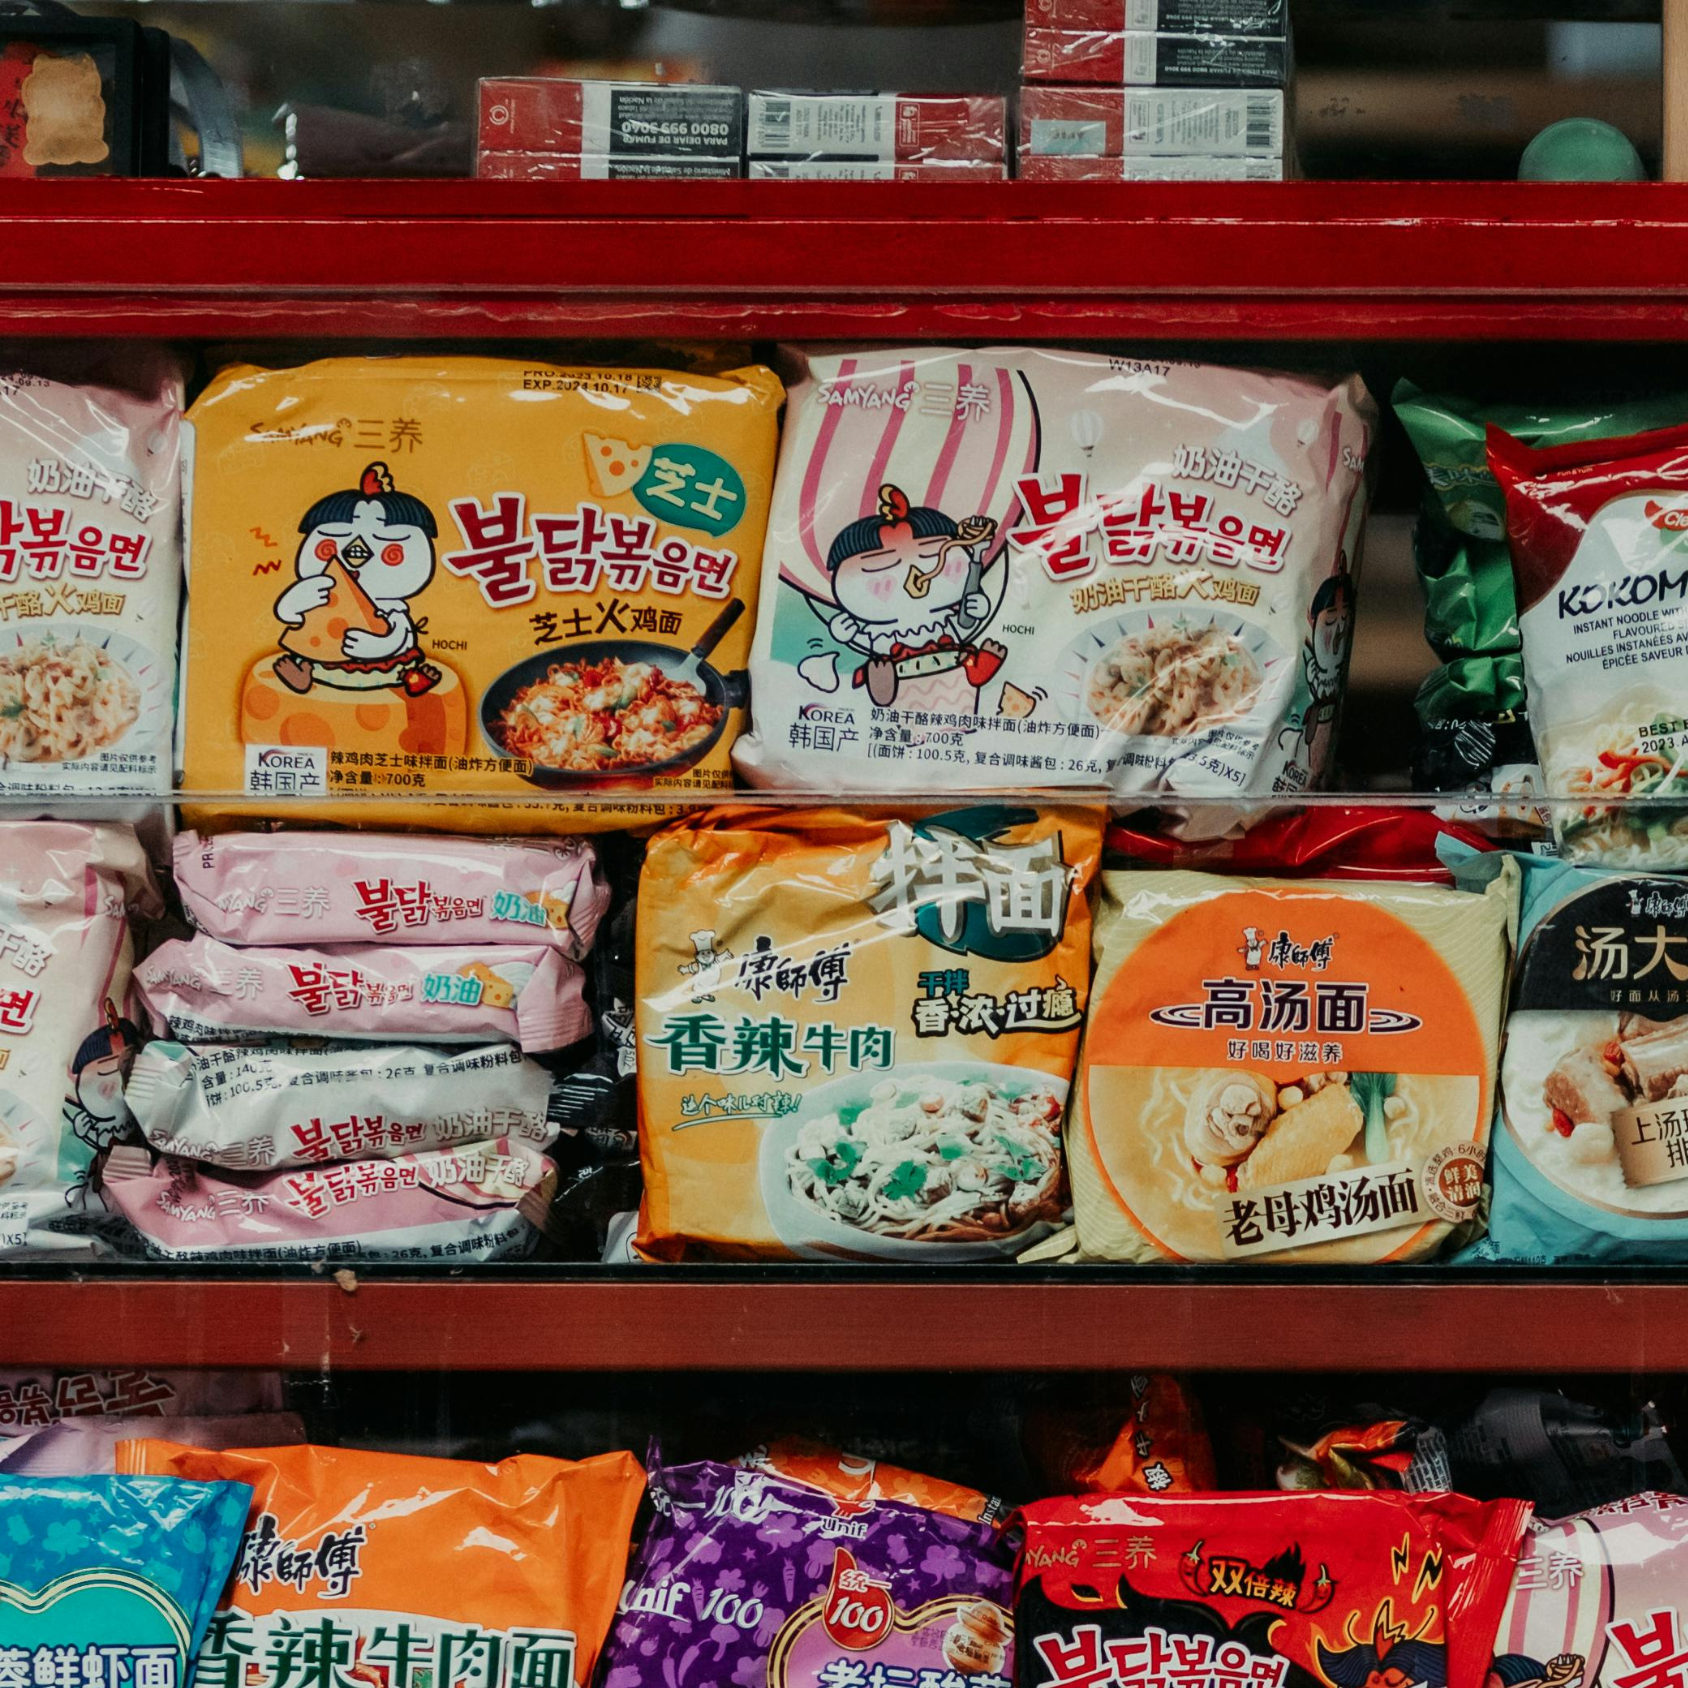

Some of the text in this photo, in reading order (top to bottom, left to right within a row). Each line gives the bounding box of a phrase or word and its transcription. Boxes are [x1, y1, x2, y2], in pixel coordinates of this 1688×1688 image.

[817, 381, 991, 421] SAMYANG 三养
[648, 457, 738, 520] 芝士
[1172, 443, 1301, 516] 奶油干酪
[1009, 472, 1289, 577] 불닭볶음면
[448, 496, 737, 602] 불닭볶음면
[529, 599, 682, 645] 芝士火鸡面
[1002, 624, 1035, 636] HOCHI
[432, 639, 468, 651] HOCHI
[1566, 646, 1614, 663] NOUILLES
[1603, 654, 1639, 670] ÉPICÉE
[1642, 649, 1683, 663] SAVEUR
[799, 707, 855, 725] KOREA
[1639, 720, 1679, 739] BEST
[789, 724, 860, 752] 韩国产
[258, 752, 314, 770] KOREA
[275, 886, 330, 918] 三养
[875, 821, 1064, 941] 拌面
[735, 936, 849, 1001] 康師傅
[1268, 932, 1334, 970] 康師傅
[287, 962, 481, 1014] 불닭볶음면 奶油
[918, 969, 969, 994] 干拌
[1202, 978, 1369, 1033] 高汤面
[647, 1014, 894, 1077] 香辣牛肉
[1227, 1040, 1343, 1062] 好喝好滋养
[292, 1108, 547, 1163] 불닭볶음면 奶油干酪
[287, 1157, 528, 1220] 불닭볶음면 奶油干酪
[1223, 1167, 1419, 1247] 老母鸡汤面
[1210, 1559, 1298, 1607] 双倍辣
[828, 1600, 884, 1632] 100
